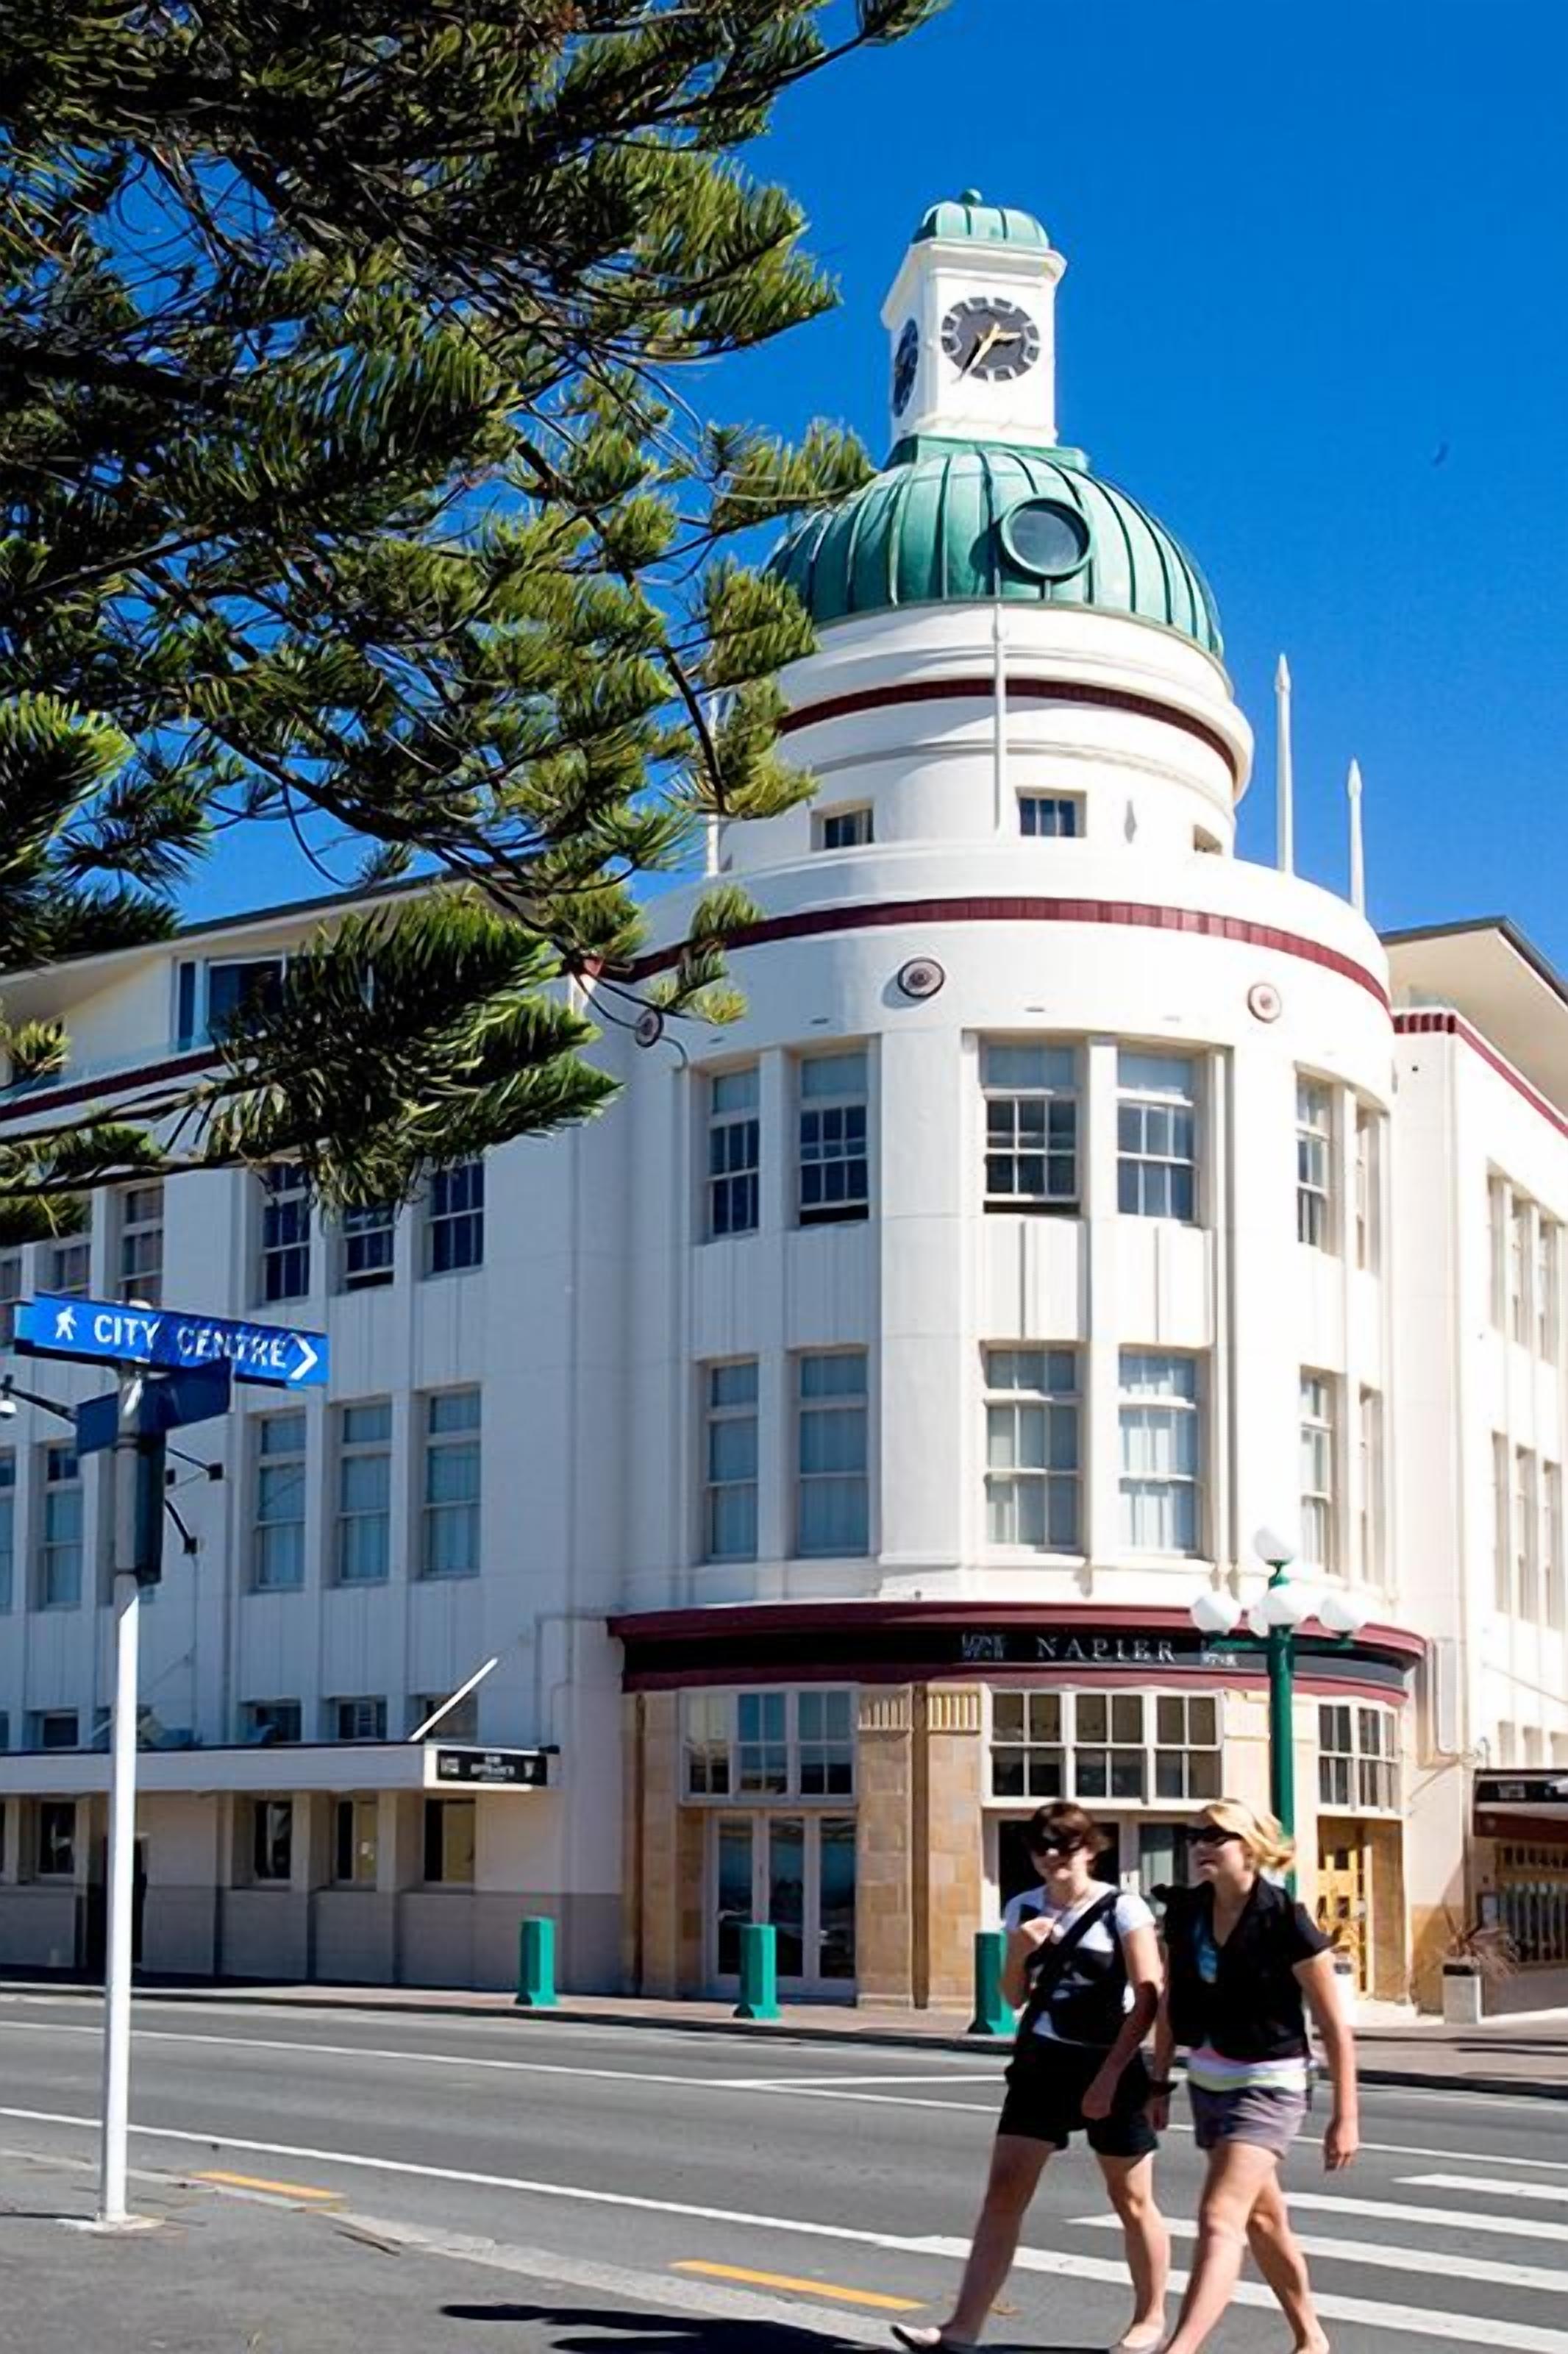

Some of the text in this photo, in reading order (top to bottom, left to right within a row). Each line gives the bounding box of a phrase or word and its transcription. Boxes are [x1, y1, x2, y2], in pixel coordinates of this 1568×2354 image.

[94, 1315, 287, 1368] CITY CENTRE
[1036, 1635, 1176, 1663] NAPIER
